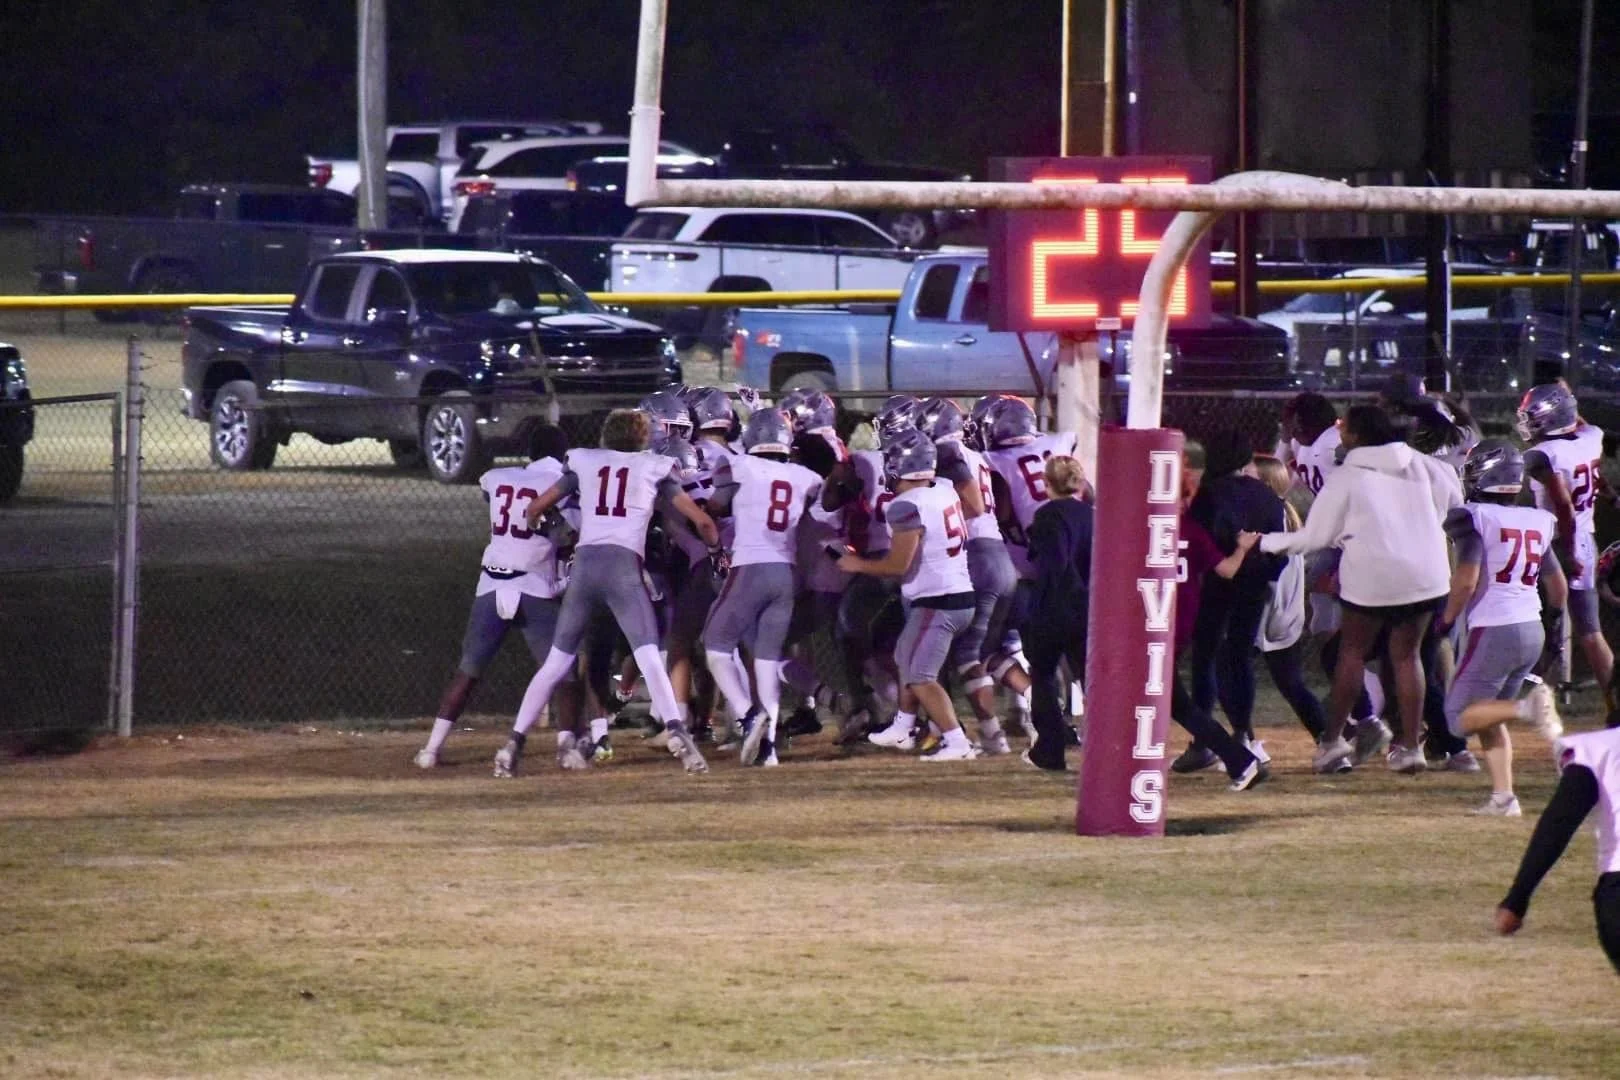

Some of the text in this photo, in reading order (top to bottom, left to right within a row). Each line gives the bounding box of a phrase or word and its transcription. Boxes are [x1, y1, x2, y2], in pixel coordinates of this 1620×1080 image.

[1032, 177, 1187, 318] 25
[595, 466, 629, 517] 11
[1016, 450, 1052, 502] 6
[492, 485, 538, 539] 33
[767, 480, 793, 532] 8
[1495, 527, 1542, 586] 76
[1129, 450, 1179, 823] DEVILS
